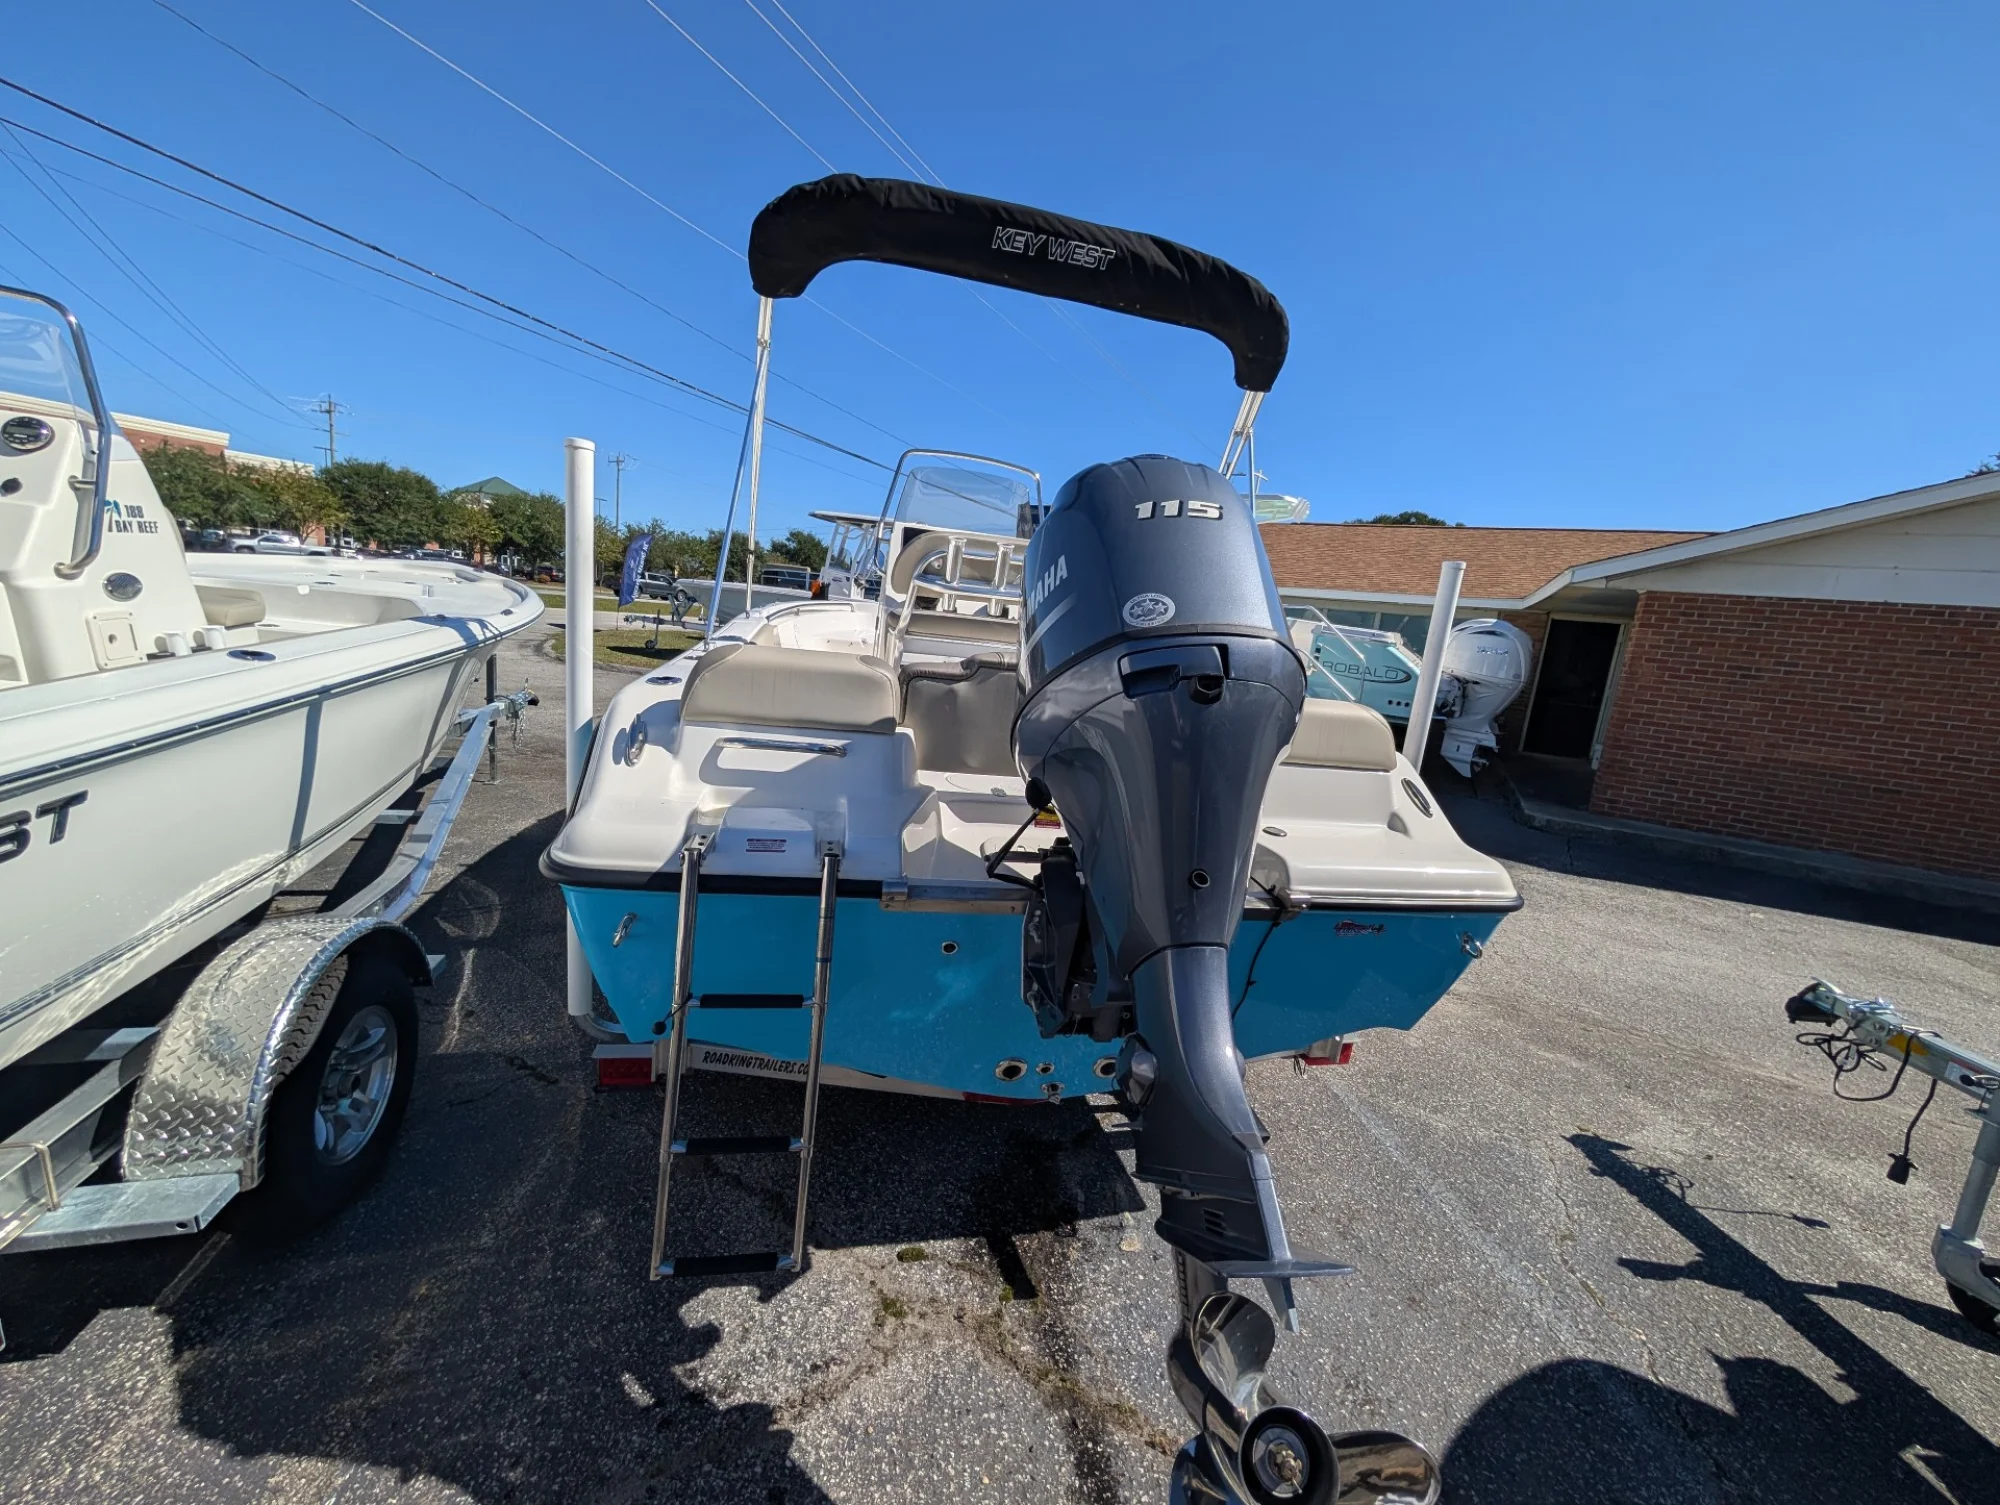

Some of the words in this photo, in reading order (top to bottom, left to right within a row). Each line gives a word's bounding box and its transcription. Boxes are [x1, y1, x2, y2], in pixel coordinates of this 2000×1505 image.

[992, 226, 1047, 256] KEY
[1048, 237, 1116, 270] WEST
[1135, 500, 1223, 520] 115
[115, 520, 133, 533] BAY
[137, 520, 158, 534] REEF
[1322, 660, 1399, 680] ROBALO
